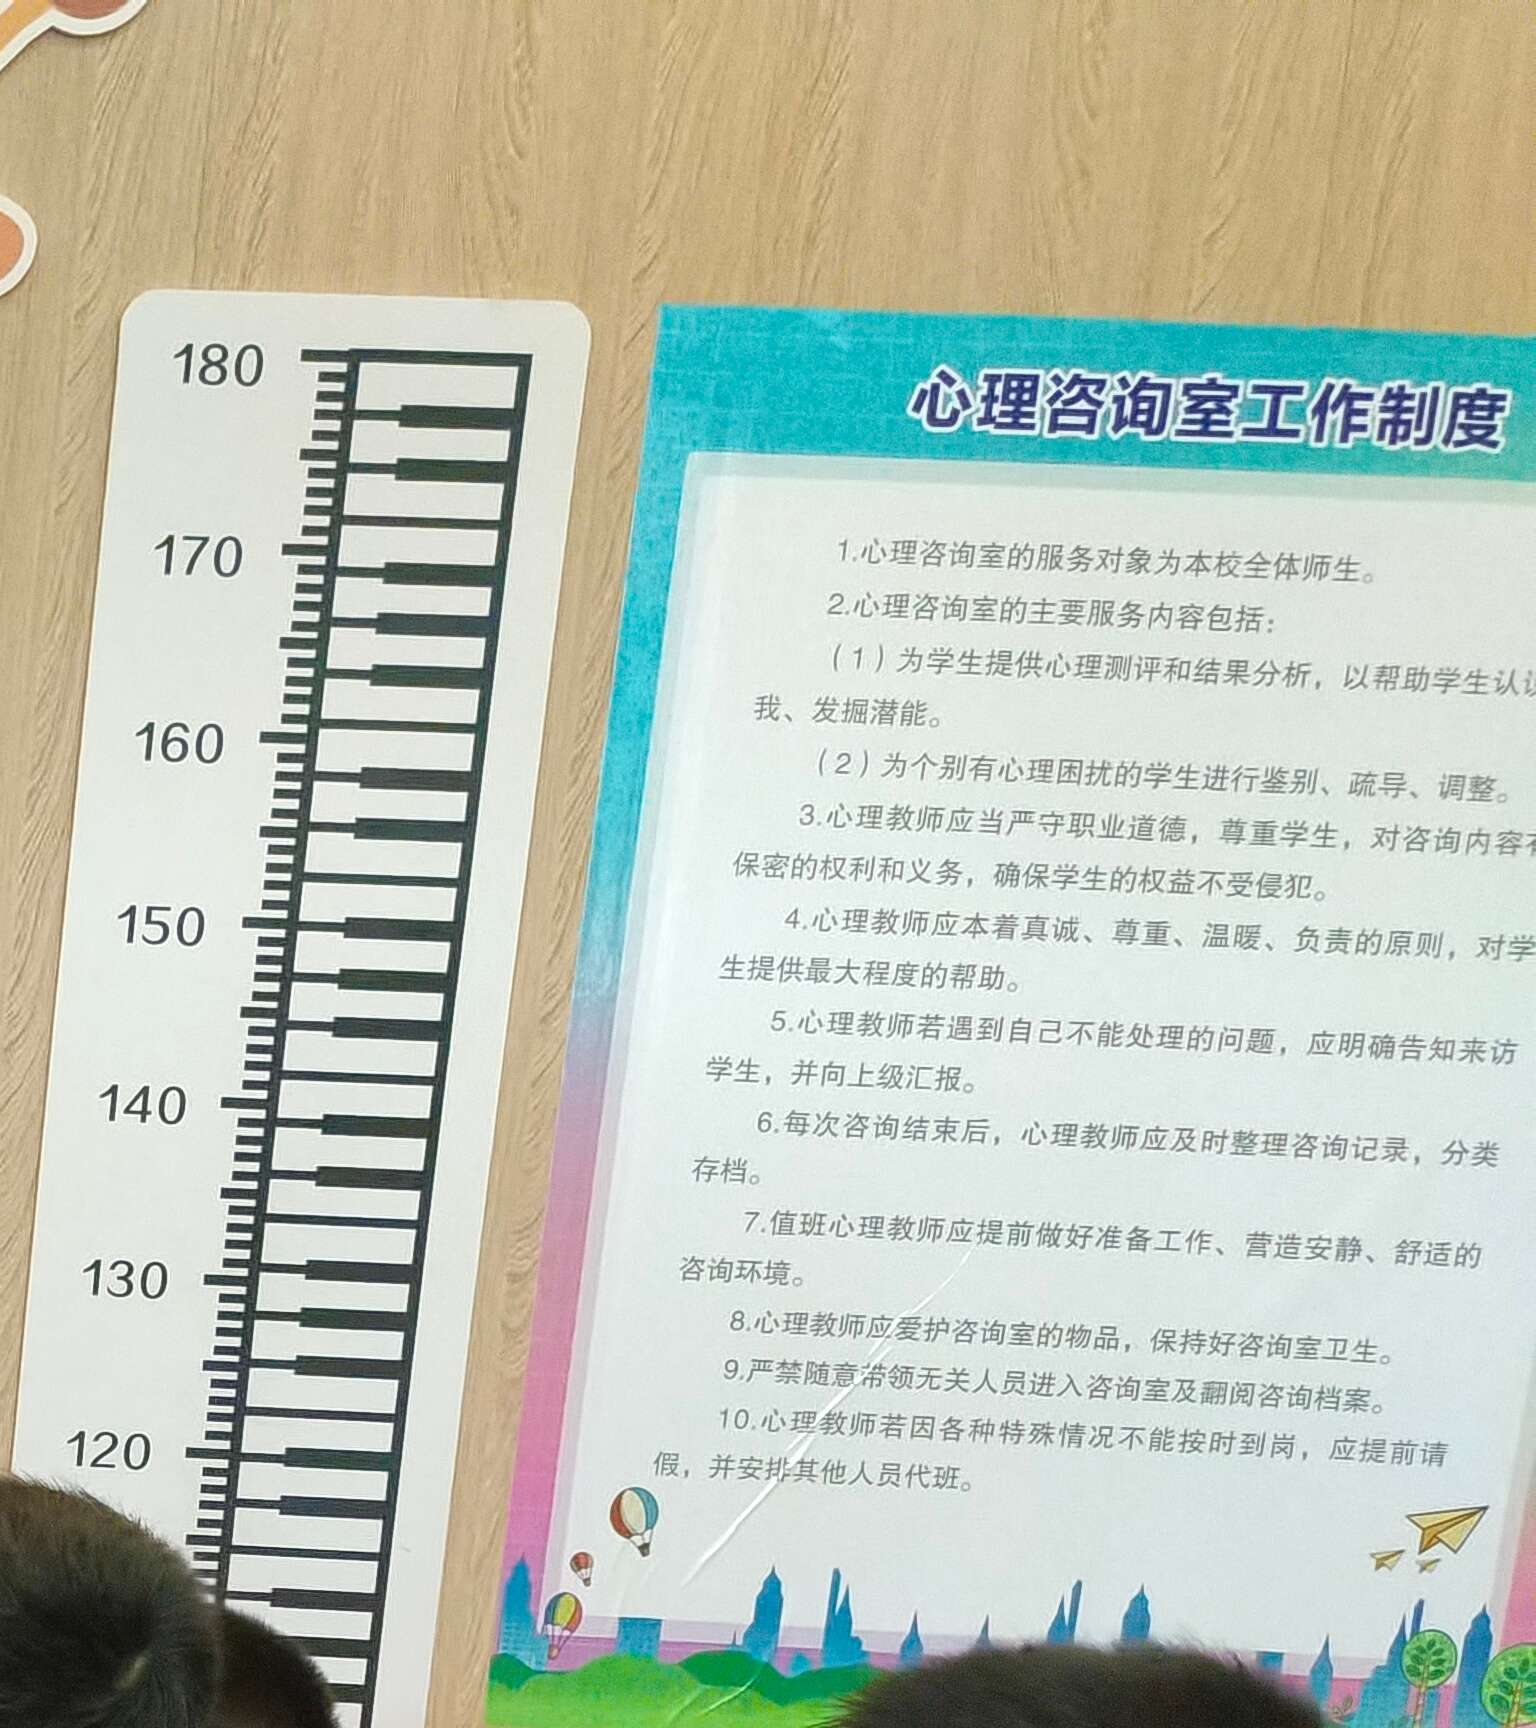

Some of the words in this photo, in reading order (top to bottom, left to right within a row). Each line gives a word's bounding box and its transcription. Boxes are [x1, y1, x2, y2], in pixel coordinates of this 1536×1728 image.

[171, 341, 265, 388] 180
[909, 368, 1510, 451] 心理咨询室工作制度
[153, 533, 244, 579] 170
[837, 537, 1375, 586] 1.心理咨询室的服务对象为本校全体师生。
[827, 592, 1276, 635] 2.心理咨询室的主要服务内容包括：
[753, 694, 947, 730] 我、发掘潜能。
[133, 721, 225, 766] 160
[731, 850, 1328, 903] 保密的权利和义务，确保学生的权益不受侵犯。
[117, 903, 206, 947] 150
[718, 954, 1022, 994] 生提供最大程度的帮助。
[769, 1009, 1519, 1067] 5.心理教师若遇到自己不能处理的问题，应明确告知来访
[704, 1055, 978, 1095] 学生，并向上级汇报。
[97, 1083, 187, 1125] 140
[756, 1109, 1502, 1169] 6.每次咨询结束后，心理教师应及时整理咨询记录，分类
[690, 1155, 762, 1187] 存档。
[80, 1259, 169, 1300] 130
[678, 1256, 806, 1289] 咨询环境。
[729, 1309, 1394, 1367] 8.心理教师应爱护咨询室的物品，保持好咨询室卫生。
[65, 1430, 152, 1471] 120
[652, 1450, 975, 1493] 假，并安排其他人员代班。
